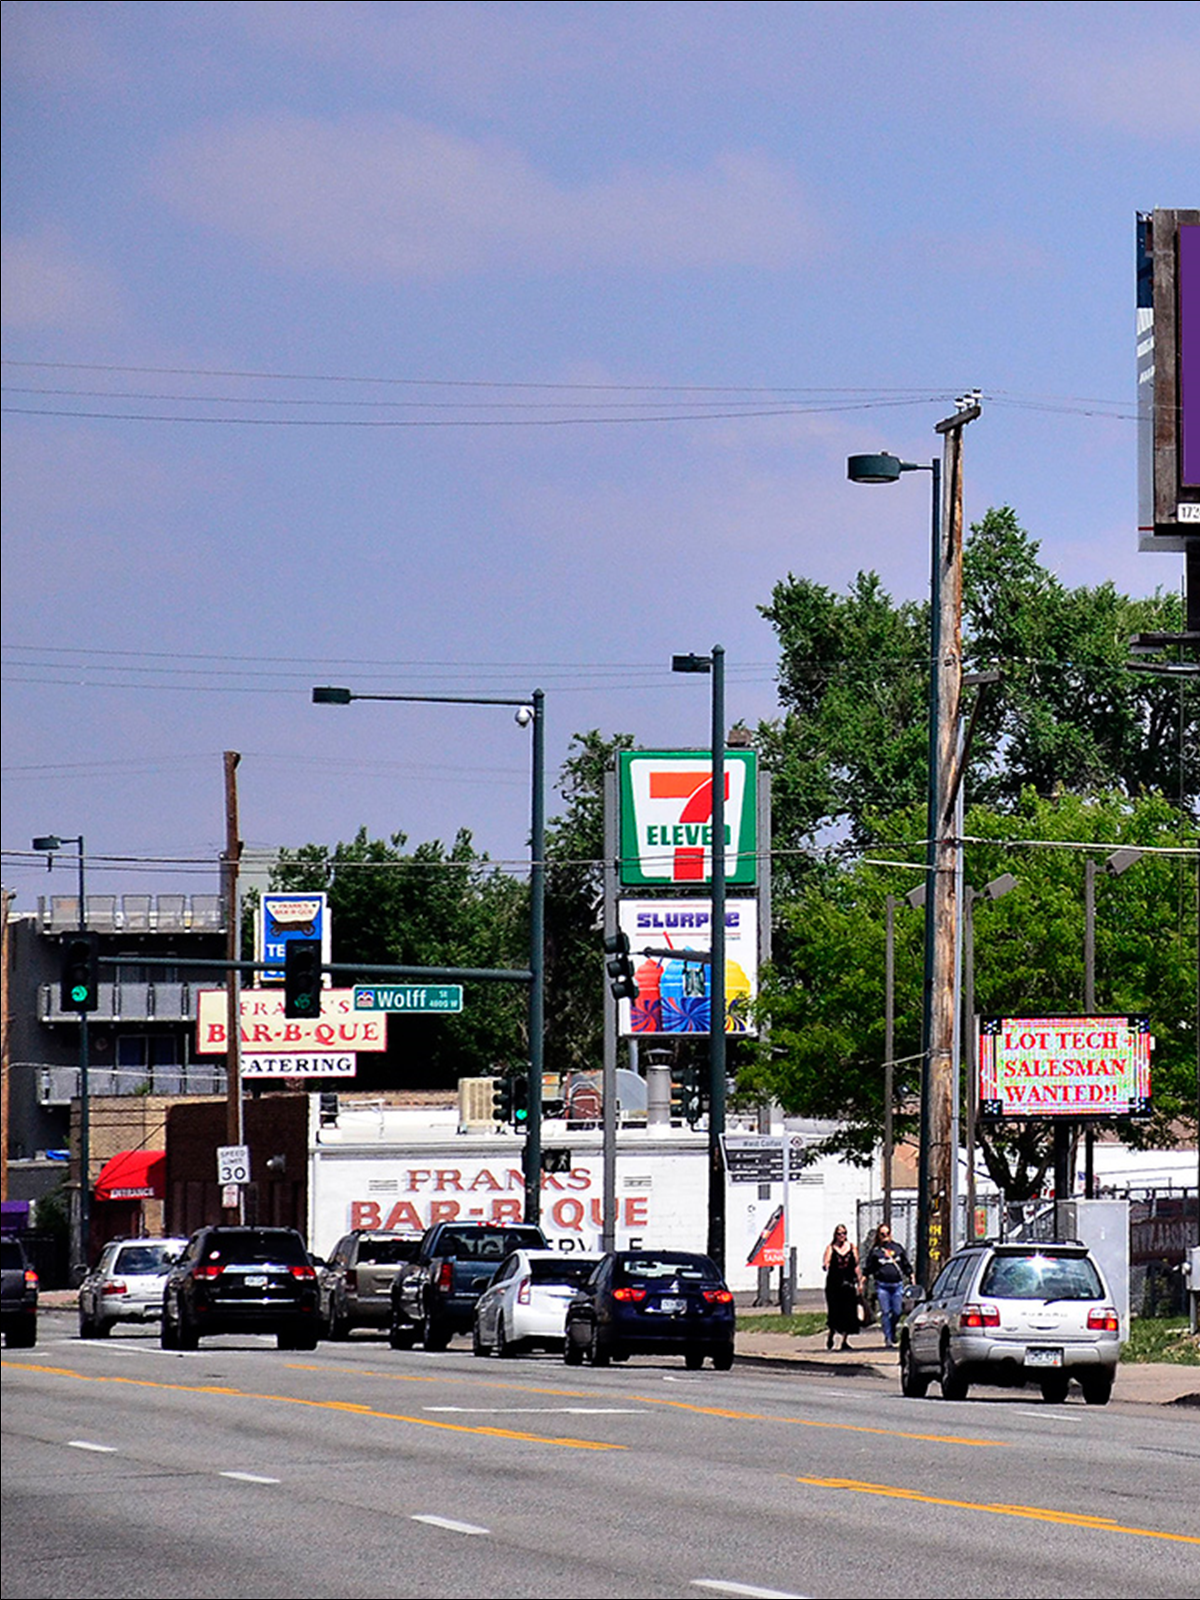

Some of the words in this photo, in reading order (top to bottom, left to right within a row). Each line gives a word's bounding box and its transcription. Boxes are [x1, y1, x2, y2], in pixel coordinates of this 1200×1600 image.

[649, 771, 730, 881] 7
[377, 989, 427, 1008] Wolff
[1005, 1032, 1050, 1050] LOT
[1056, 1032, 1118, 1050] TECH
[1004, 1058, 1127, 1077] SALESMAN
[1004, 1085, 1118, 1103] WANTED!!
[221, 1167, 246, 1180] 30
[110, 1187, 154, 1198] ENTRANCE
